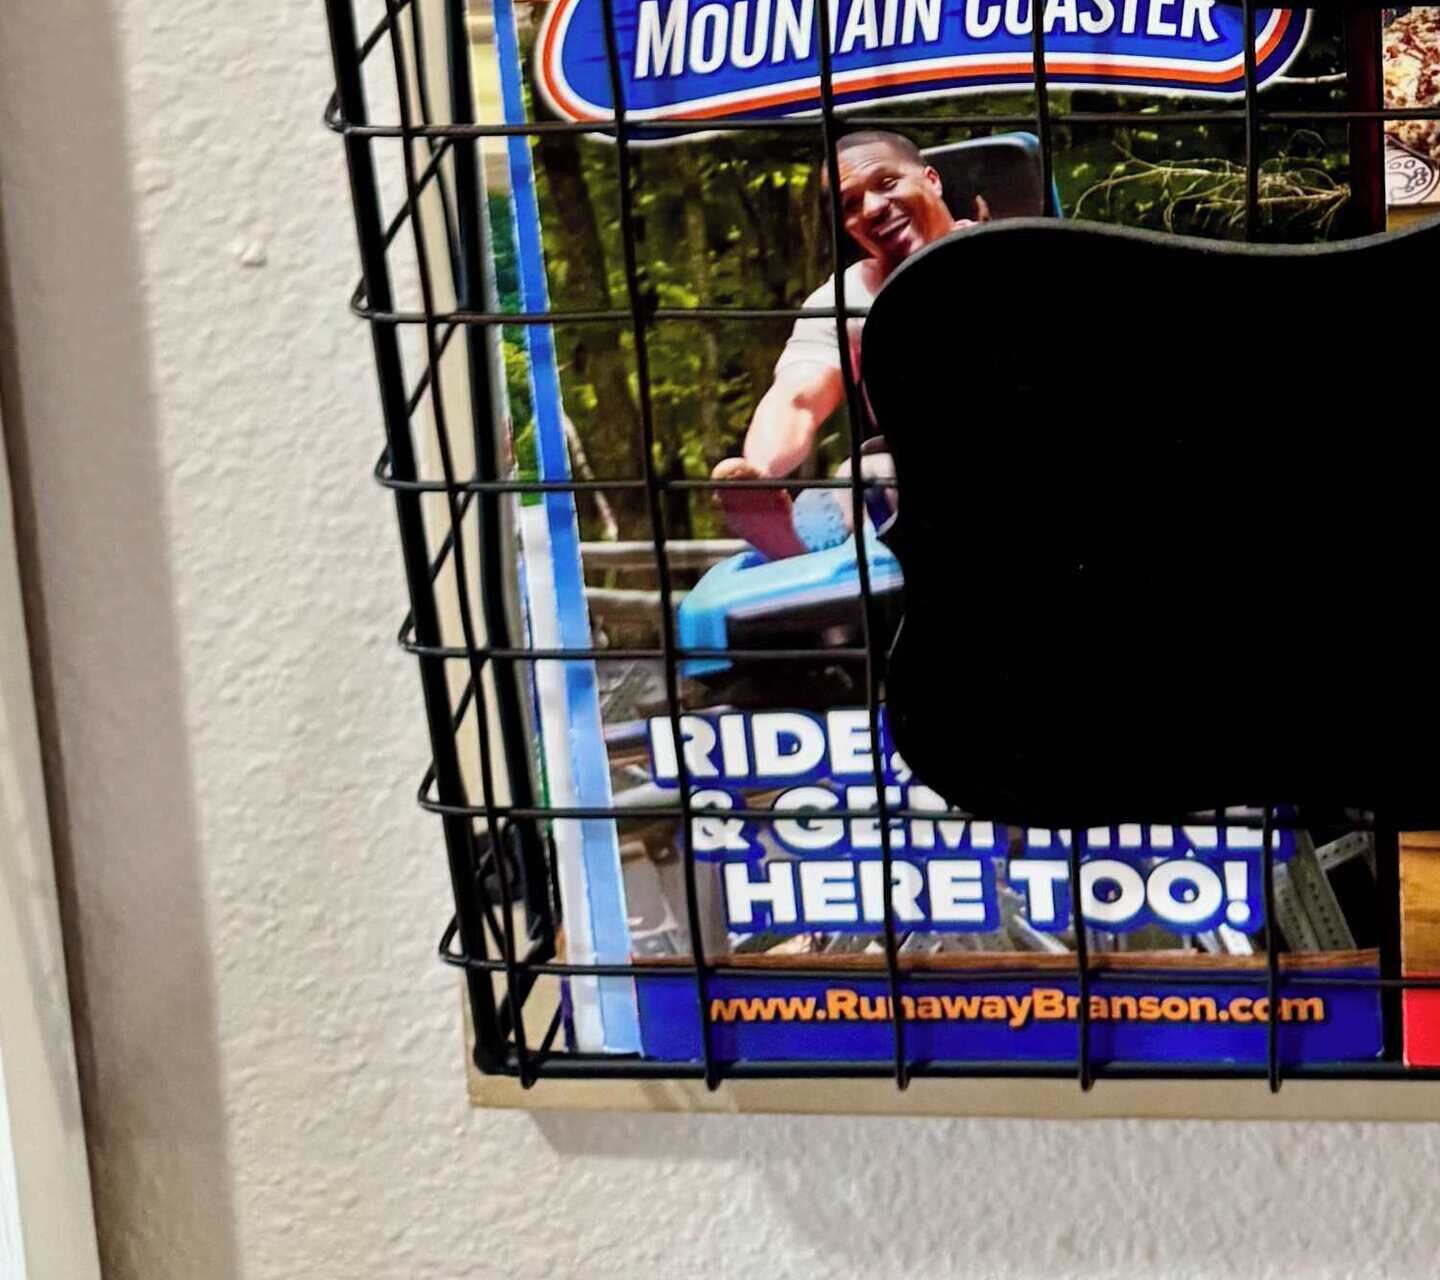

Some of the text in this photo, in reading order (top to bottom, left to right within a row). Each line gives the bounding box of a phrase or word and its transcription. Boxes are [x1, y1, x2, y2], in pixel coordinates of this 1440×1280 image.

[690, 789, 751, 853] &
[723, 858, 1251, 925] HERE TOO!
[710, 987, 1325, 1030] www.RunawayBranson.com
